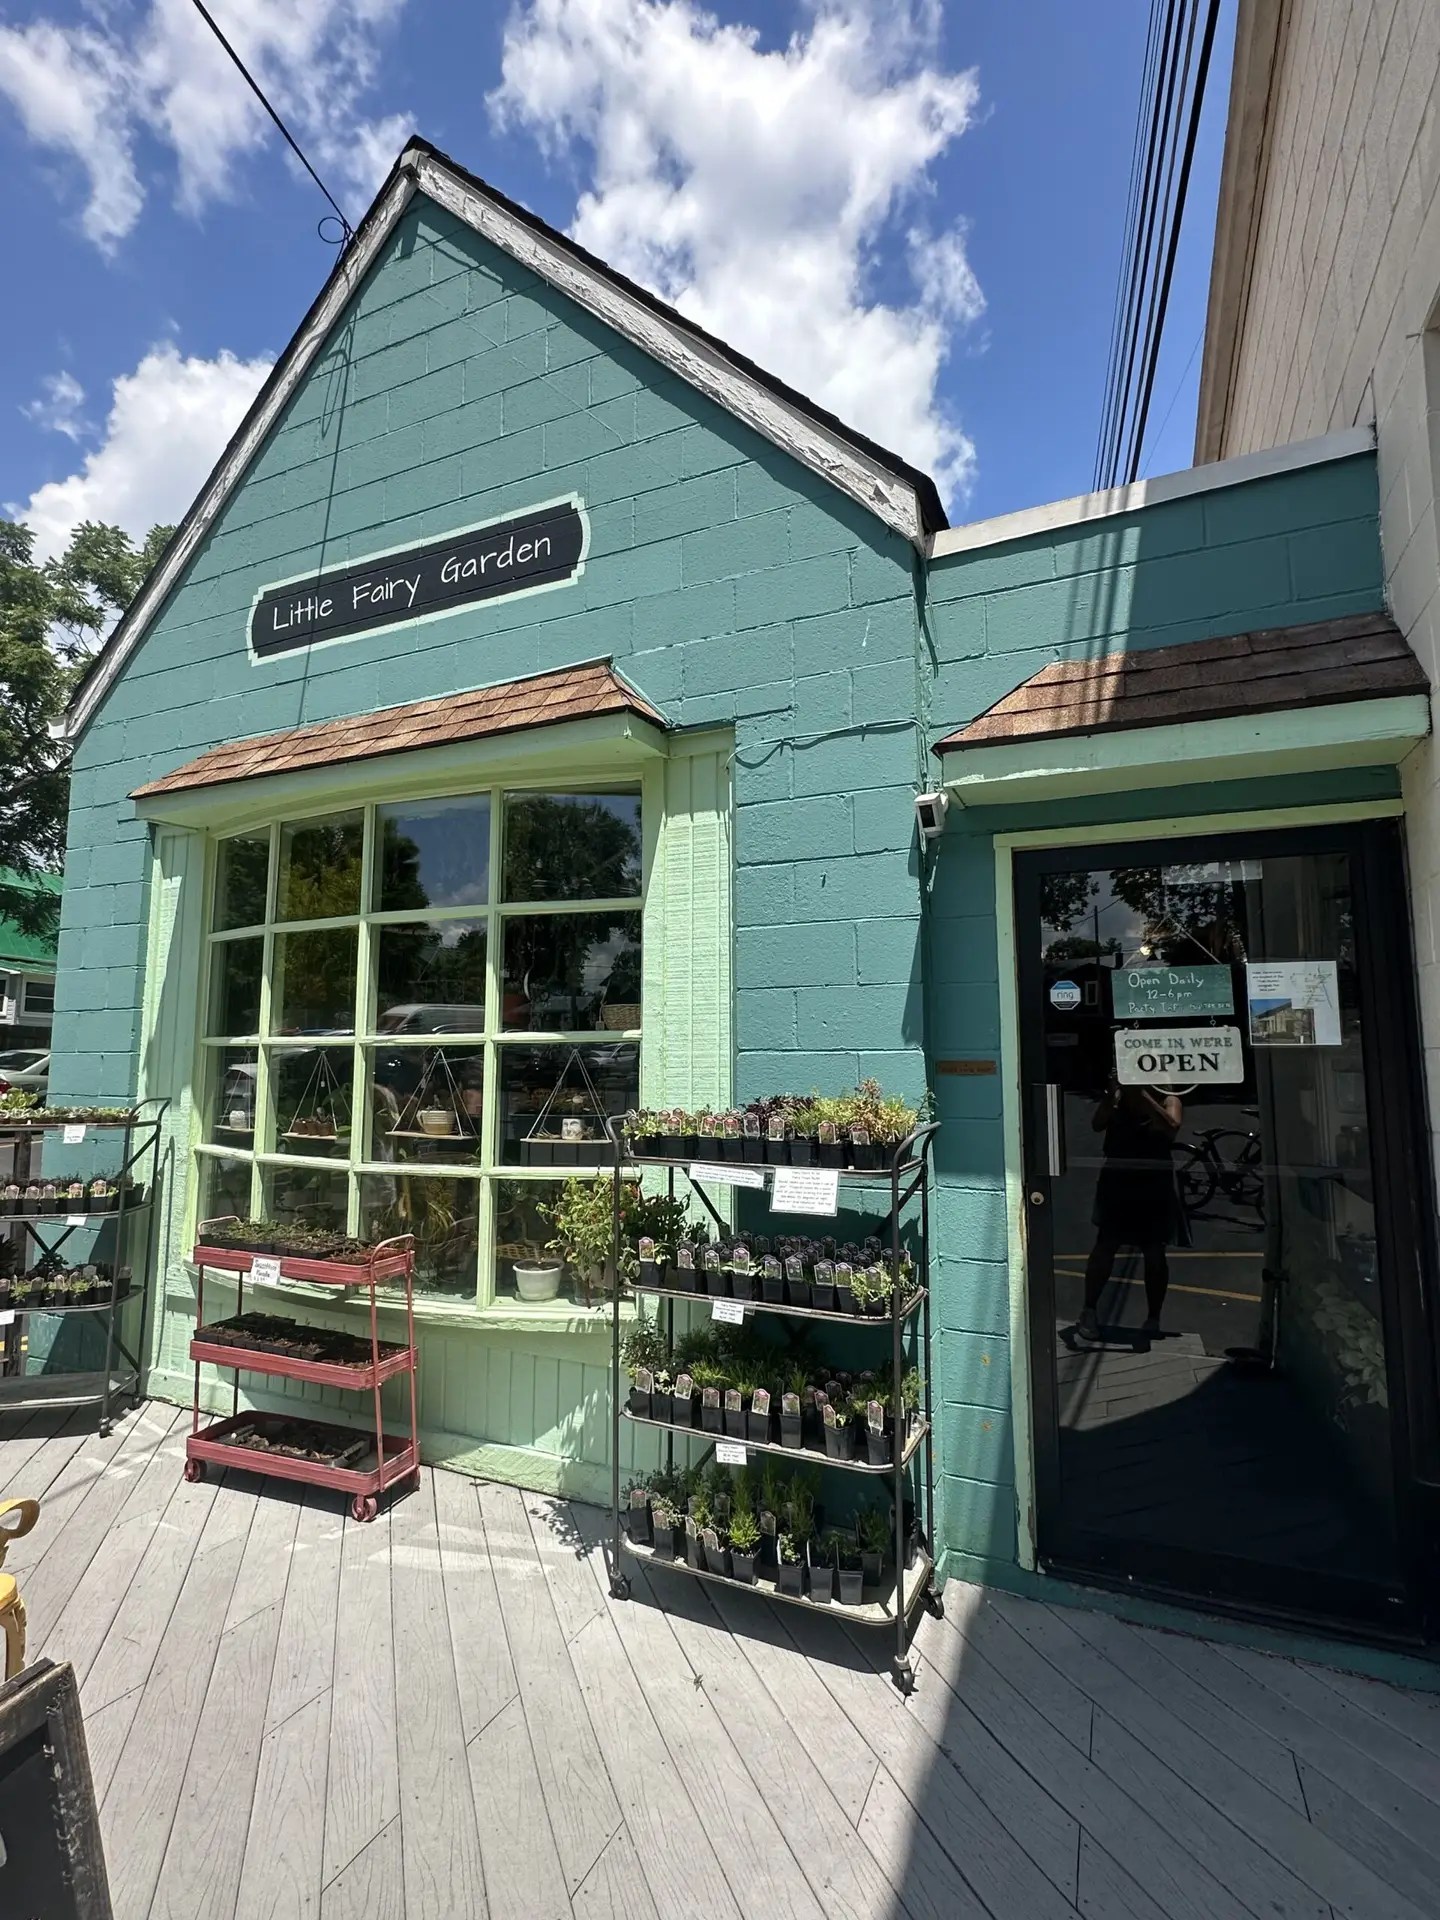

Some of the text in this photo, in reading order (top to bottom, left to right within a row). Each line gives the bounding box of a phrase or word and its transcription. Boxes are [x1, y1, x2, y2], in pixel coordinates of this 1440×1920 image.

[273, 536, 552, 631] Little Fairy Garden
[1128, 971, 1205, 989] Open Daily
[1056, 990, 1074, 1001] ring
[1123, 1038, 1161, 1050] COME
[1190, 1036, 1233, 1049] WE'RE
[1136, 1052, 1221, 1074] OPEN
